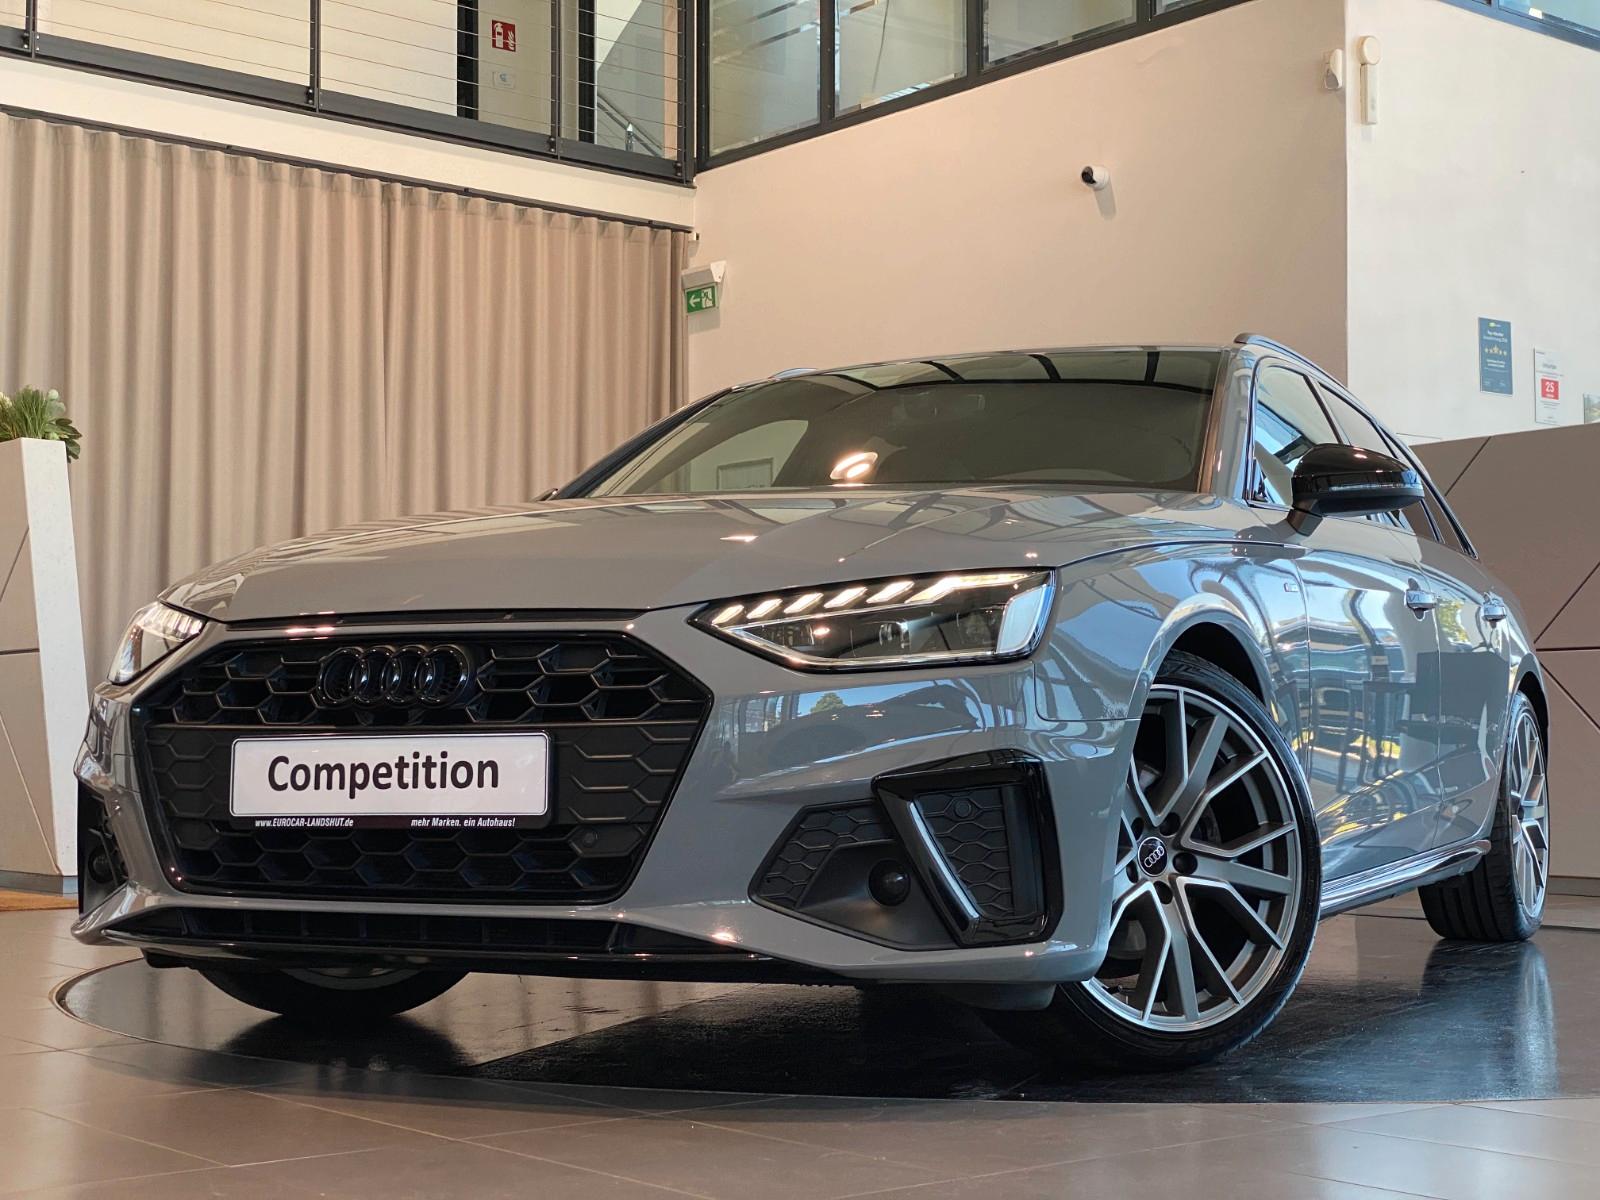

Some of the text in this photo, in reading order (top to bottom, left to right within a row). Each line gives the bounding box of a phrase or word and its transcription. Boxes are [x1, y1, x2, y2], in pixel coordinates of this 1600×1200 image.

[268, 751, 499, 799] Competition
[255, 818, 353, 827] www.EUROCAR-LANDSHUT.de
[411, 818, 430, 827] mehr
[464, 818, 475, 827] ein
[477, 818, 515, 827] Autohaus!
